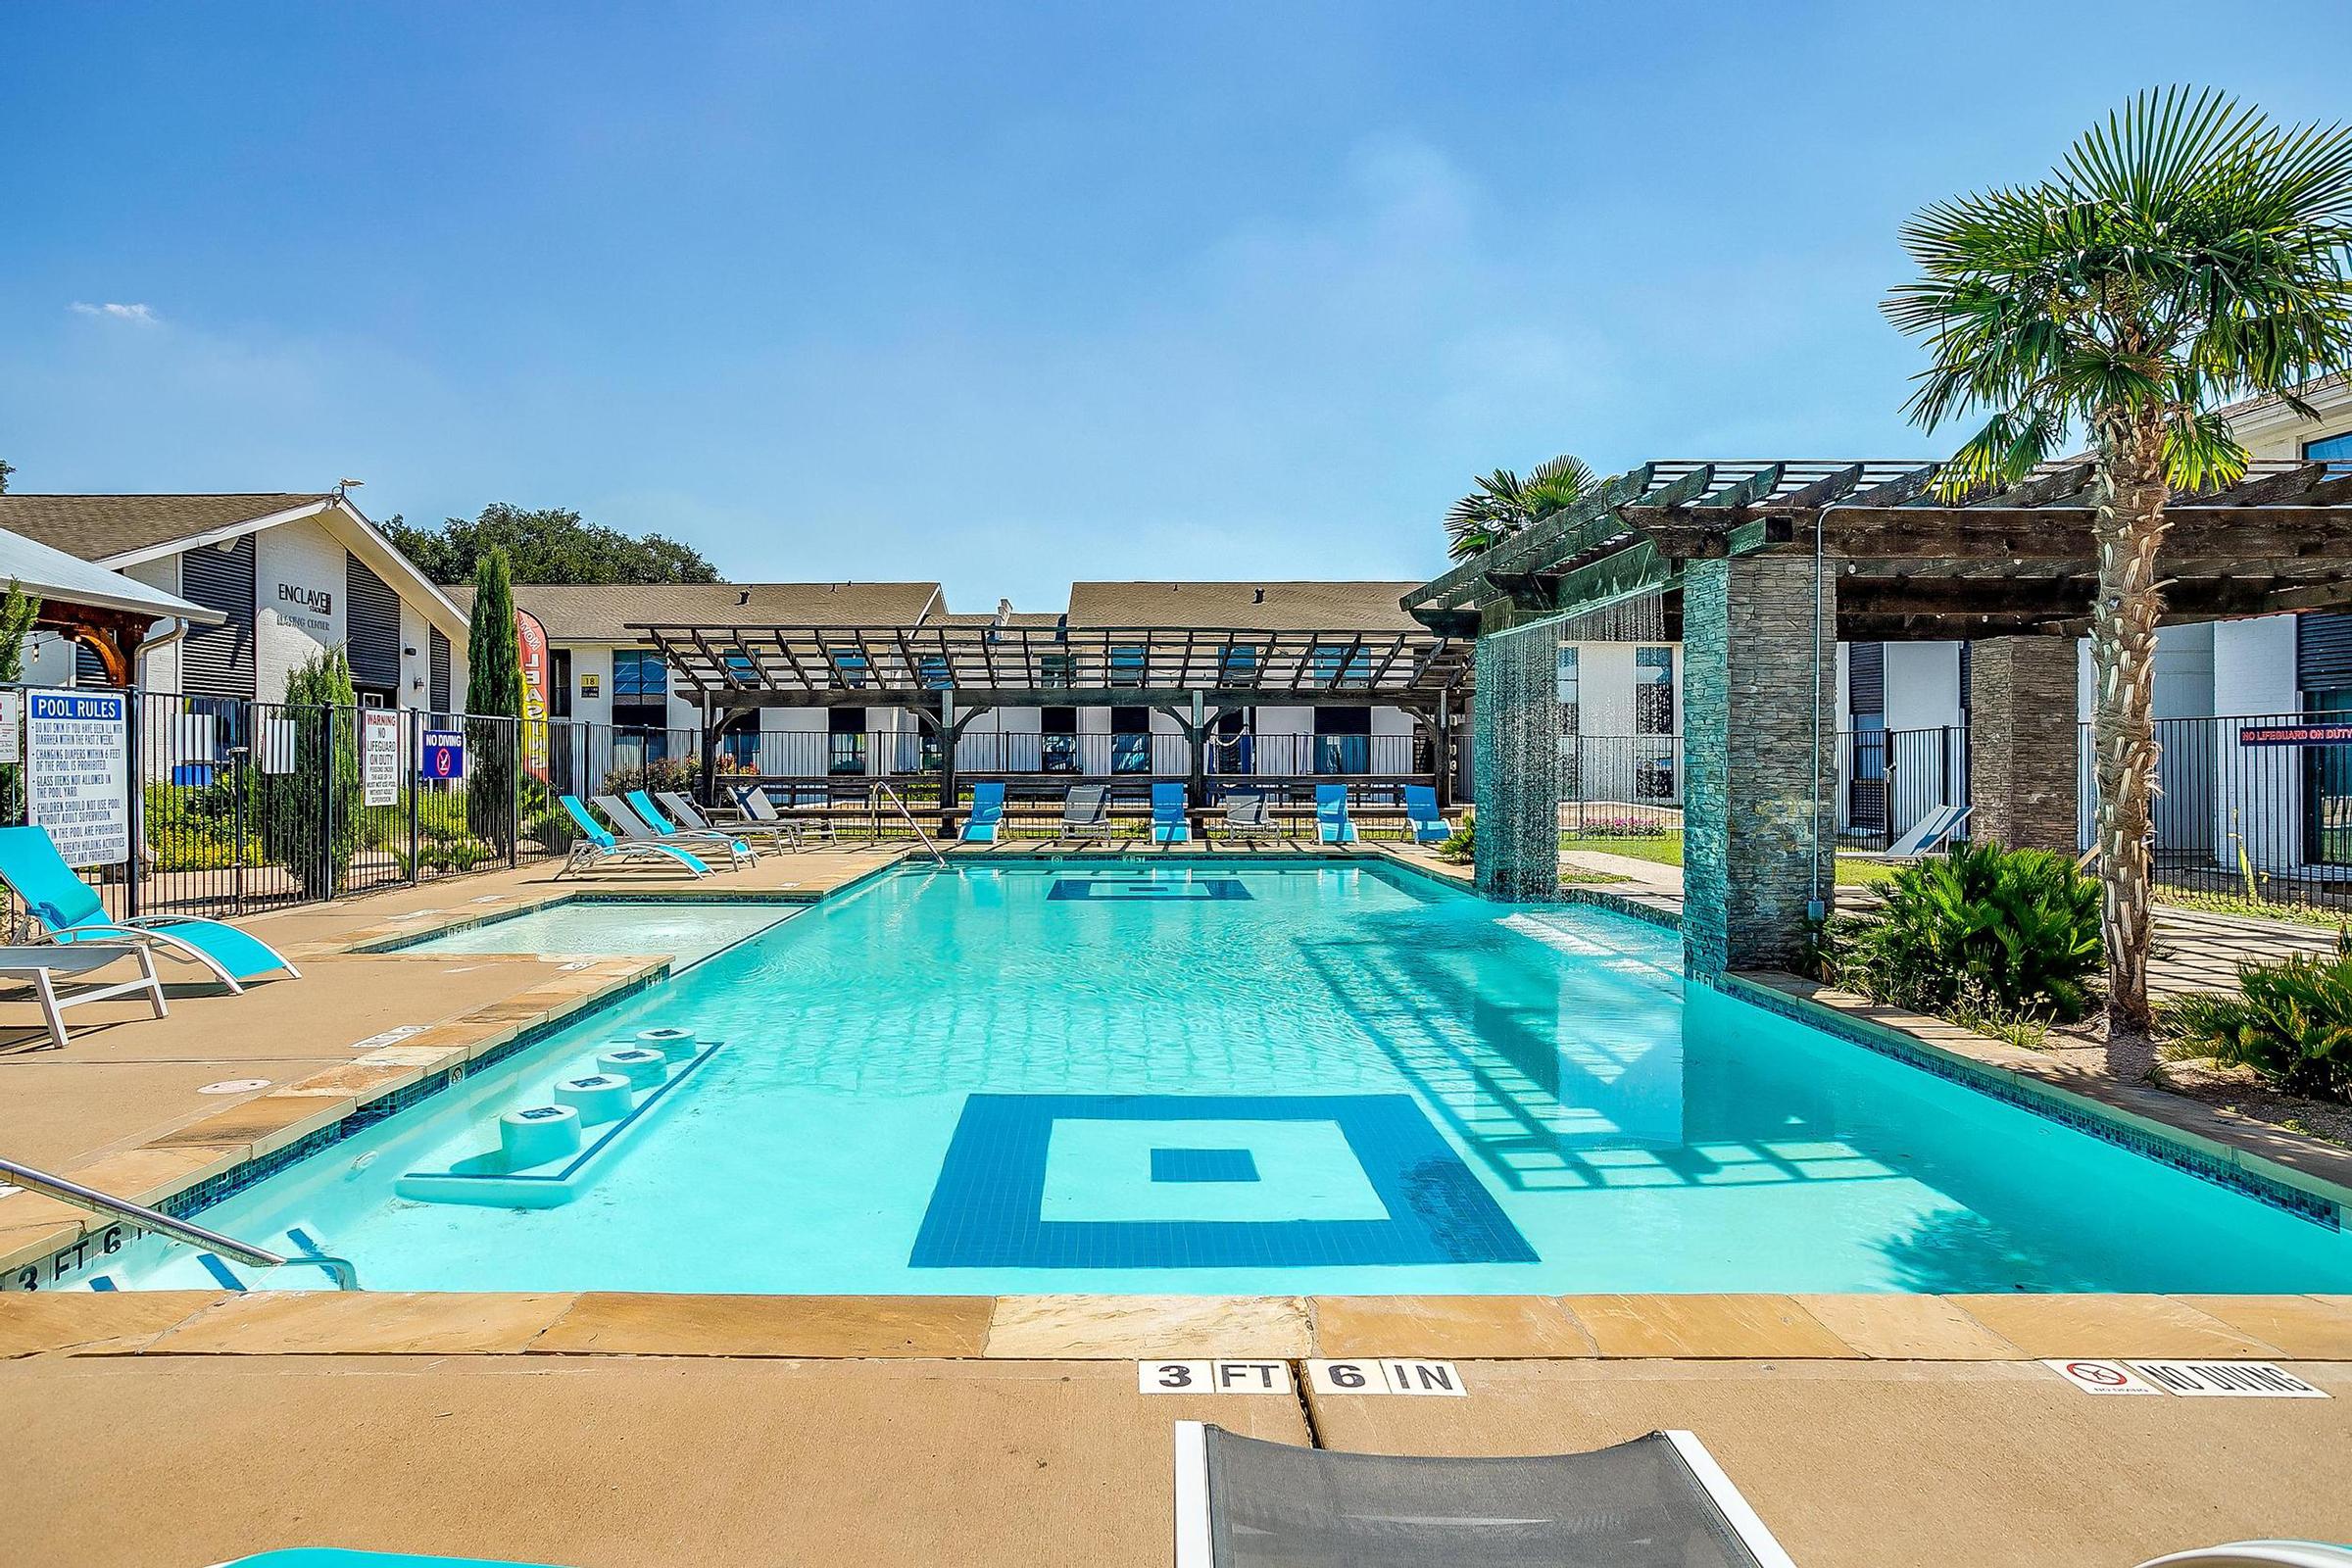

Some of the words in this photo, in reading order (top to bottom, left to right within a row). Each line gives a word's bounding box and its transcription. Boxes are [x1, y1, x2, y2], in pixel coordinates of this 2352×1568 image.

[278, 583, 327, 608] ENCLAVE
[307, 618, 330, 631] CENTER
[38, 699, 74, 716] POOL
[77, 700, 116, 718] RULES
[368, 714, 396, 726] WARNING
[73, 723, 81, 734] YOU
[377, 727, 386, 738] NO
[2241, 731, 2255, 741] NO
[2256, 729, 2308, 741] LIFEGUARD
[2309, 729, 2325, 739] ON
[2326, 728, 2352, 739] DUTY
[75, 735, 84, 745] THE
[84, 735, 95, 745] PAST
[368, 741, 396, 752] LIFEGUARD
[425, 734, 437, 746] NO
[438, 734, 462, 747] DIVING
[36, 749, 64, 760] CHANGING
[65, 749, 86, 760] DIAPERS
[86, 749, 104, 760] WITHIN
[110, 749, 121, 760] FEET
[369, 754, 378, 765] ON
[379, 754, 394, 765] DUTY
[36, 760, 43, 772] OF
[45, 760, 55, 772] THE
[56, 760, 70, 771] POOL
[71, 760, 76, 771] IS
[36, 775, 53, 787] GLASS
[55, 775, 70, 786] ITEMS
[71, 775, 80, 785] NOT
[81, 774, 105, 785] ALLOWED
[106, 774, 111, 784] IN
[36, 787, 47, 799] THE
[48, 787, 63, 798] POOL
[37, 802, 64, 813] CHILDREN
[65, 801, 85, 812] SHOULD
[86, 800, 96, 810] NOT
[97, 799, 107, 809] USE
[108, 798, 121, 809] POOL
[37, 813, 61, 825] WITHOUT
[62, 811, 77, 823] ADULT
[59, 827, 69, 838] THE
[70, 826, 83, 837] POOL
[84, 825, 94, 836] ARE
[63, 842, 80, 853] BREATH
[81, 839, 101, 851] HOLDING
[102, 837, 125, 849] ACTIVITIES
[77, 853, 87, 862] AND
[18, 1265, 38, 1292] 3
[55, 1239, 89, 1281] FT
[103, 1226, 122, 1254] 6
[1158, 1364, 1193, 1388] 3
[1221, 1364, 1280, 1388] FT
[1329, 1364, 1366, 1388] 6
[1395, 1364, 1453, 1390] IN
[2136, 1365, 2205, 1391] NO
[2186, 1365, 2314, 1392] DIVING
